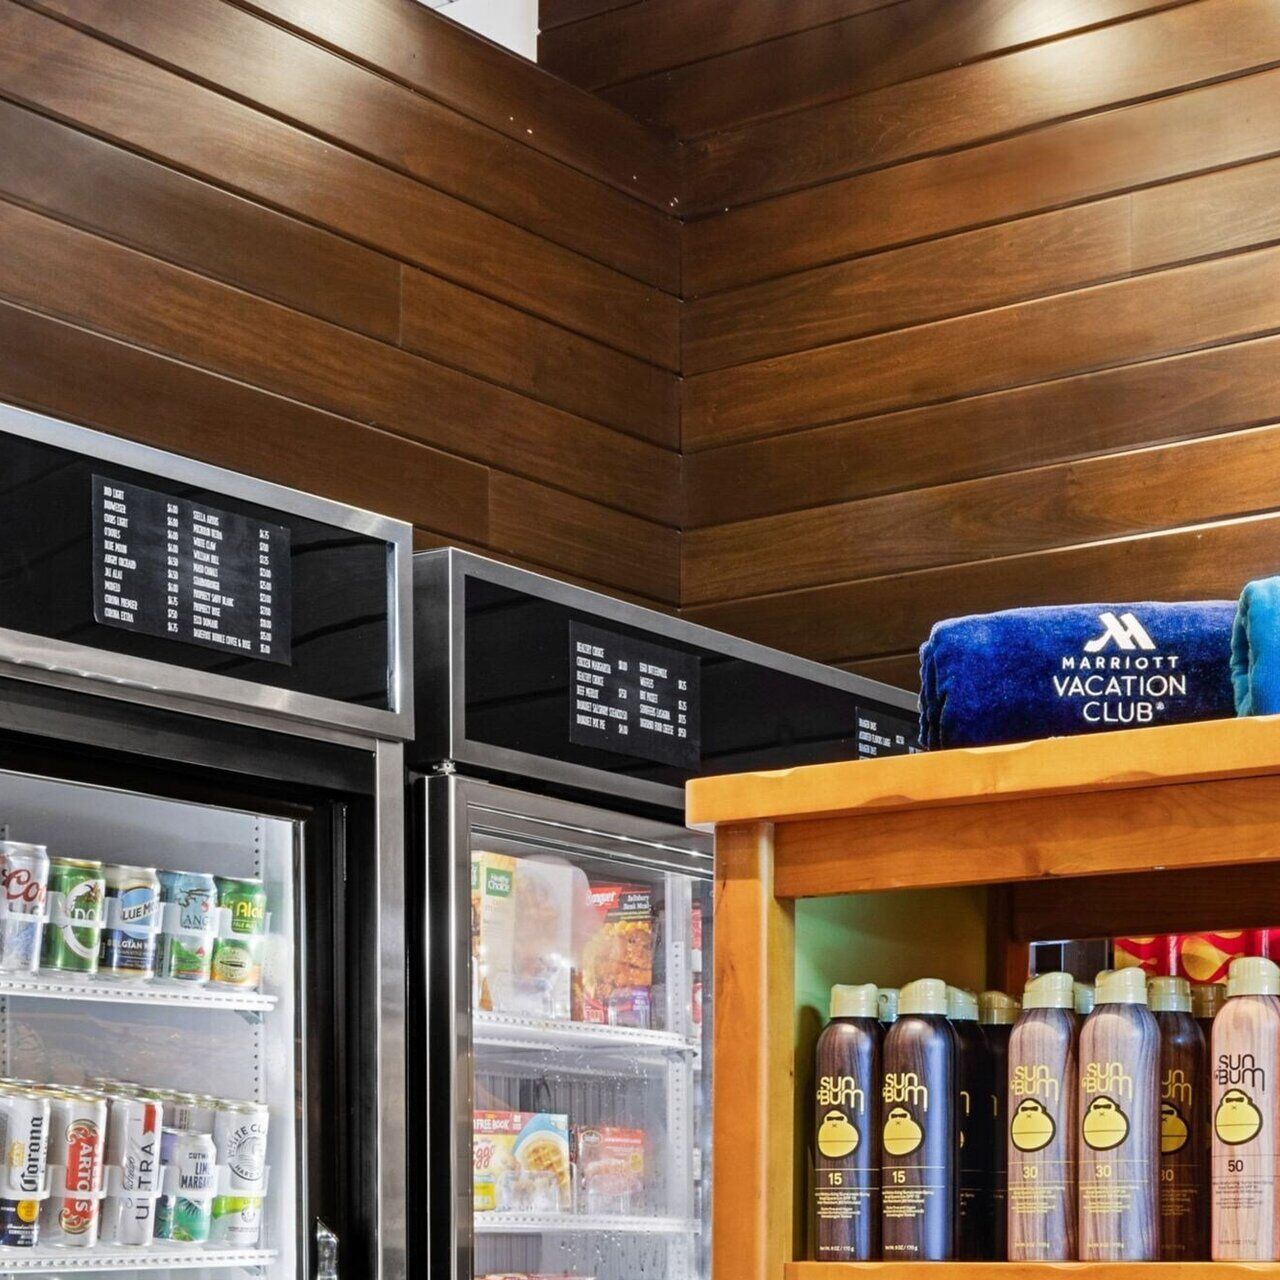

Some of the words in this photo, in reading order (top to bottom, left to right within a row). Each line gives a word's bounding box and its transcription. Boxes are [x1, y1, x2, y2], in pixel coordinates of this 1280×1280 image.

[1061, 655, 1180, 672] MARRIOTT
[1052, 674, 1187, 699] VACATION
[20, 1116, 43, 1192] Corona
[1023, 1166, 1038, 1179] 30
[1095, 1164, 1112, 1179] 30
[1227, 1159, 1244, 1173] 50
[828, 1173, 843, 1185] 15
[892, 1171, 906, 1183] 15
